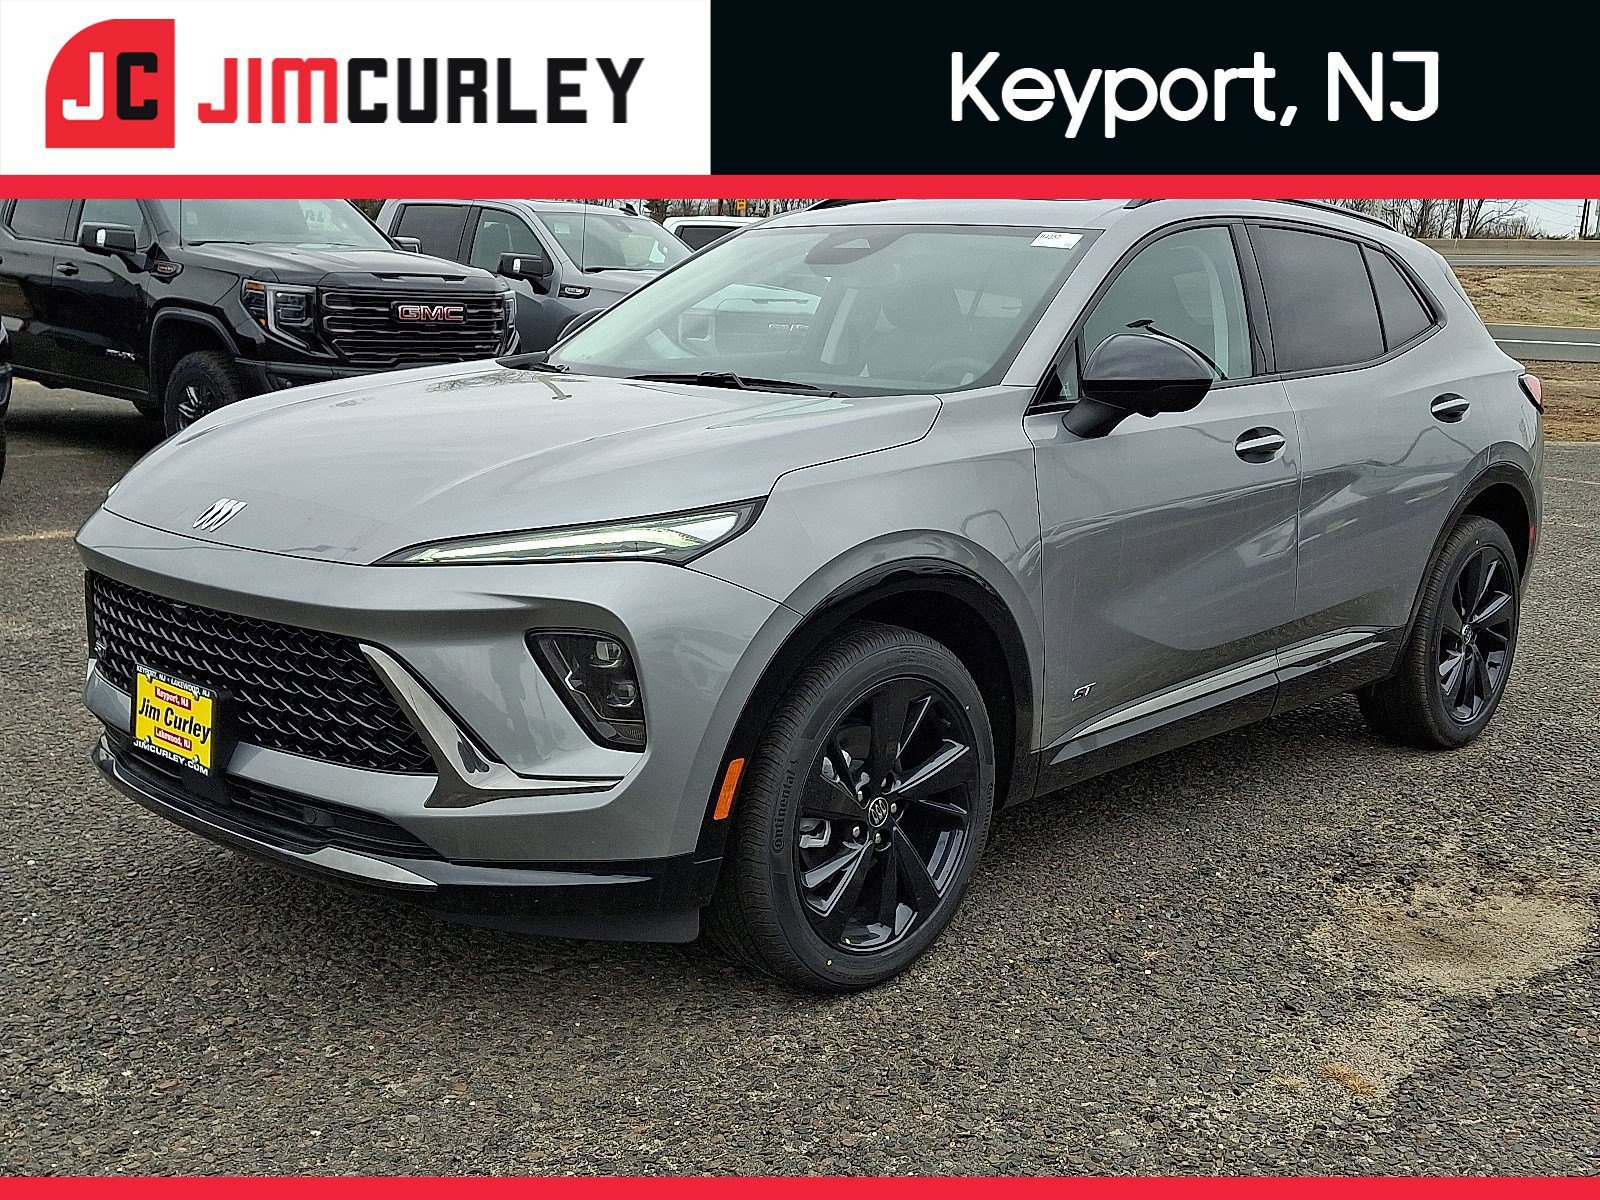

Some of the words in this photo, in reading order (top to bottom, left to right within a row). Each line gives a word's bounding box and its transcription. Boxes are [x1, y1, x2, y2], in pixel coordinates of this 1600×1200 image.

[398, 304, 464, 321] GMC
[138, 697, 161, 723] Jim
[163, 706, 211, 745] Curley
[133, 740, 209, 776] JIMCURLEY.COM
